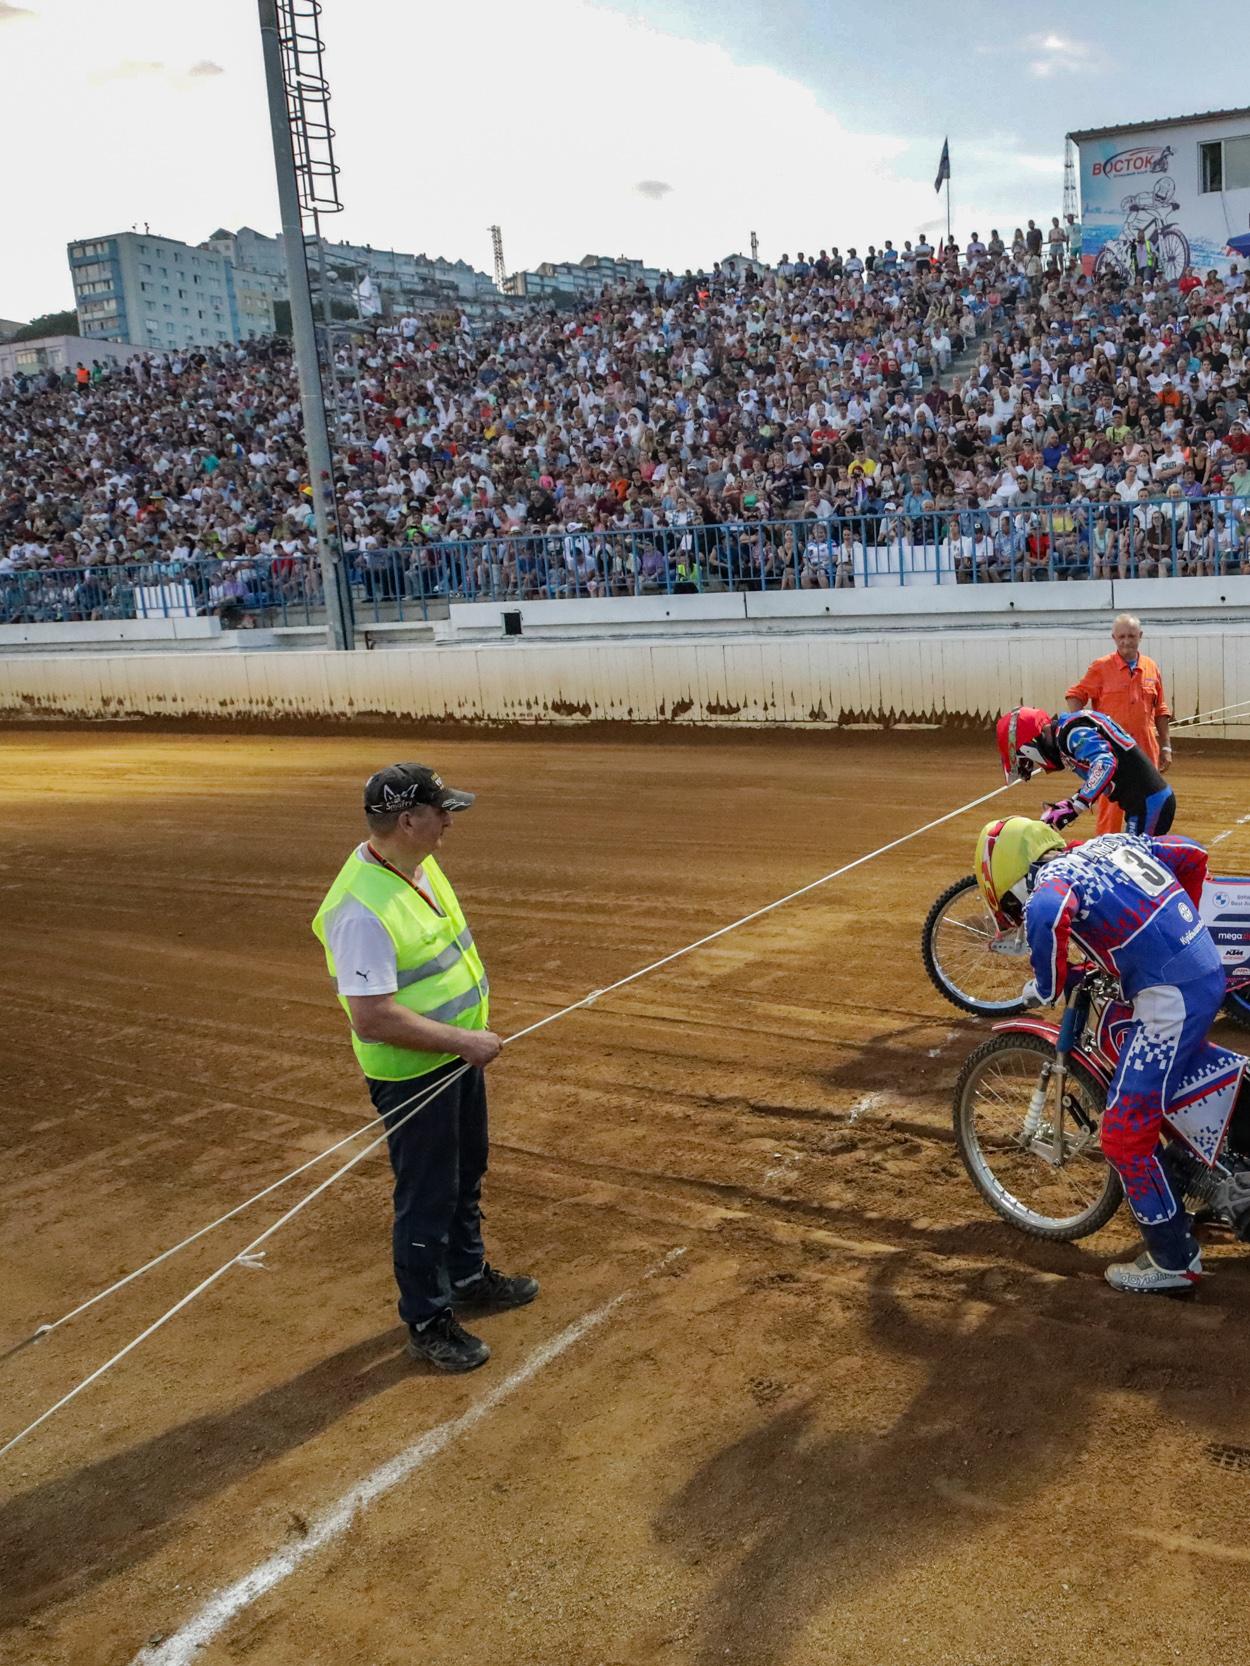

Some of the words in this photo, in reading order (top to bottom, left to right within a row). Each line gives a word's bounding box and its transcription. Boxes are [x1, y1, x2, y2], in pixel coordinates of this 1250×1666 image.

[1092, 155, 1154, 176] ВОСТОК
[1121, 849, 1166, 887] 3
[1120, 1271, 1176, 1286] daytona
